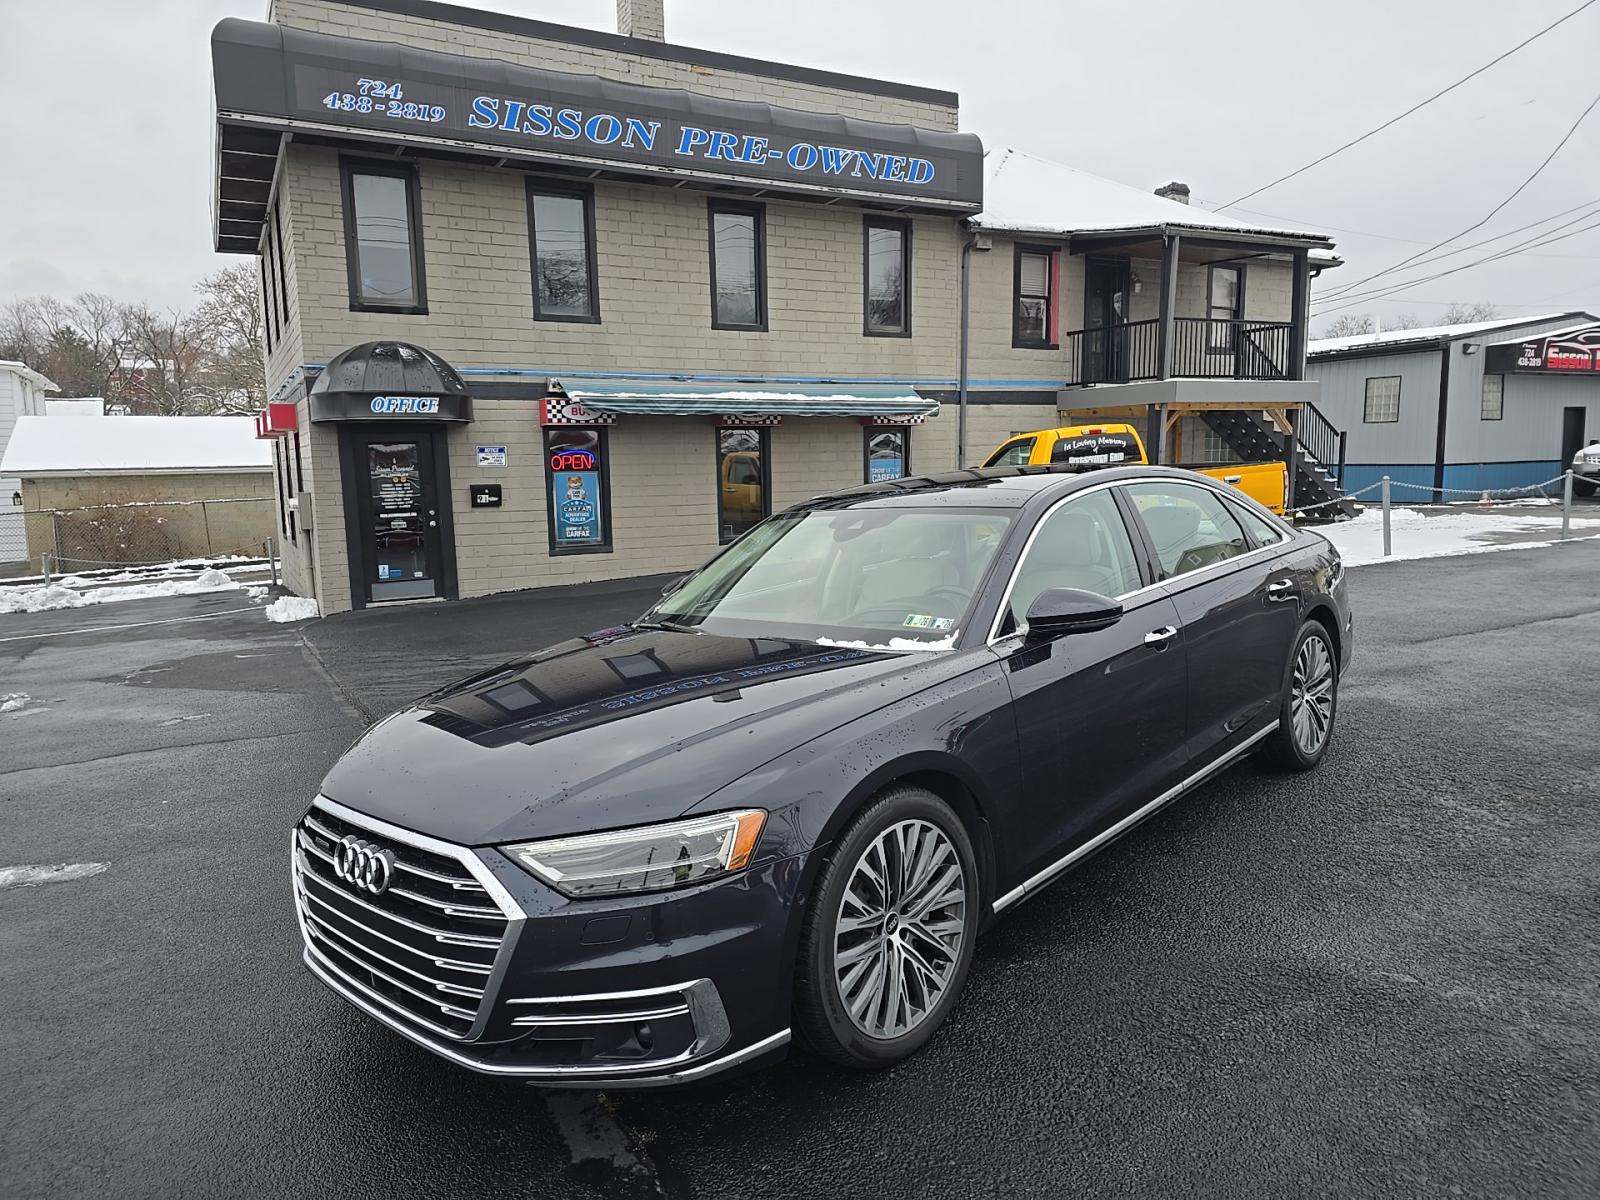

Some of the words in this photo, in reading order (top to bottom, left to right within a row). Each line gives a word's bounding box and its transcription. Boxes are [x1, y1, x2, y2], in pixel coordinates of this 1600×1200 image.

[357, 78, 403, 100] 724
[323, 92, 446, 123] 438-2819
[468, 96, 662, 151] SISSON
[675, 126, 935, 185] PRE-OWNED
[370, 396, 440, 413] OFFICE
[1073, 439, 1096, 448] Loving
[1098, 436, 1127, 448] Memory
[551, 455, 592, 470] OPEN
